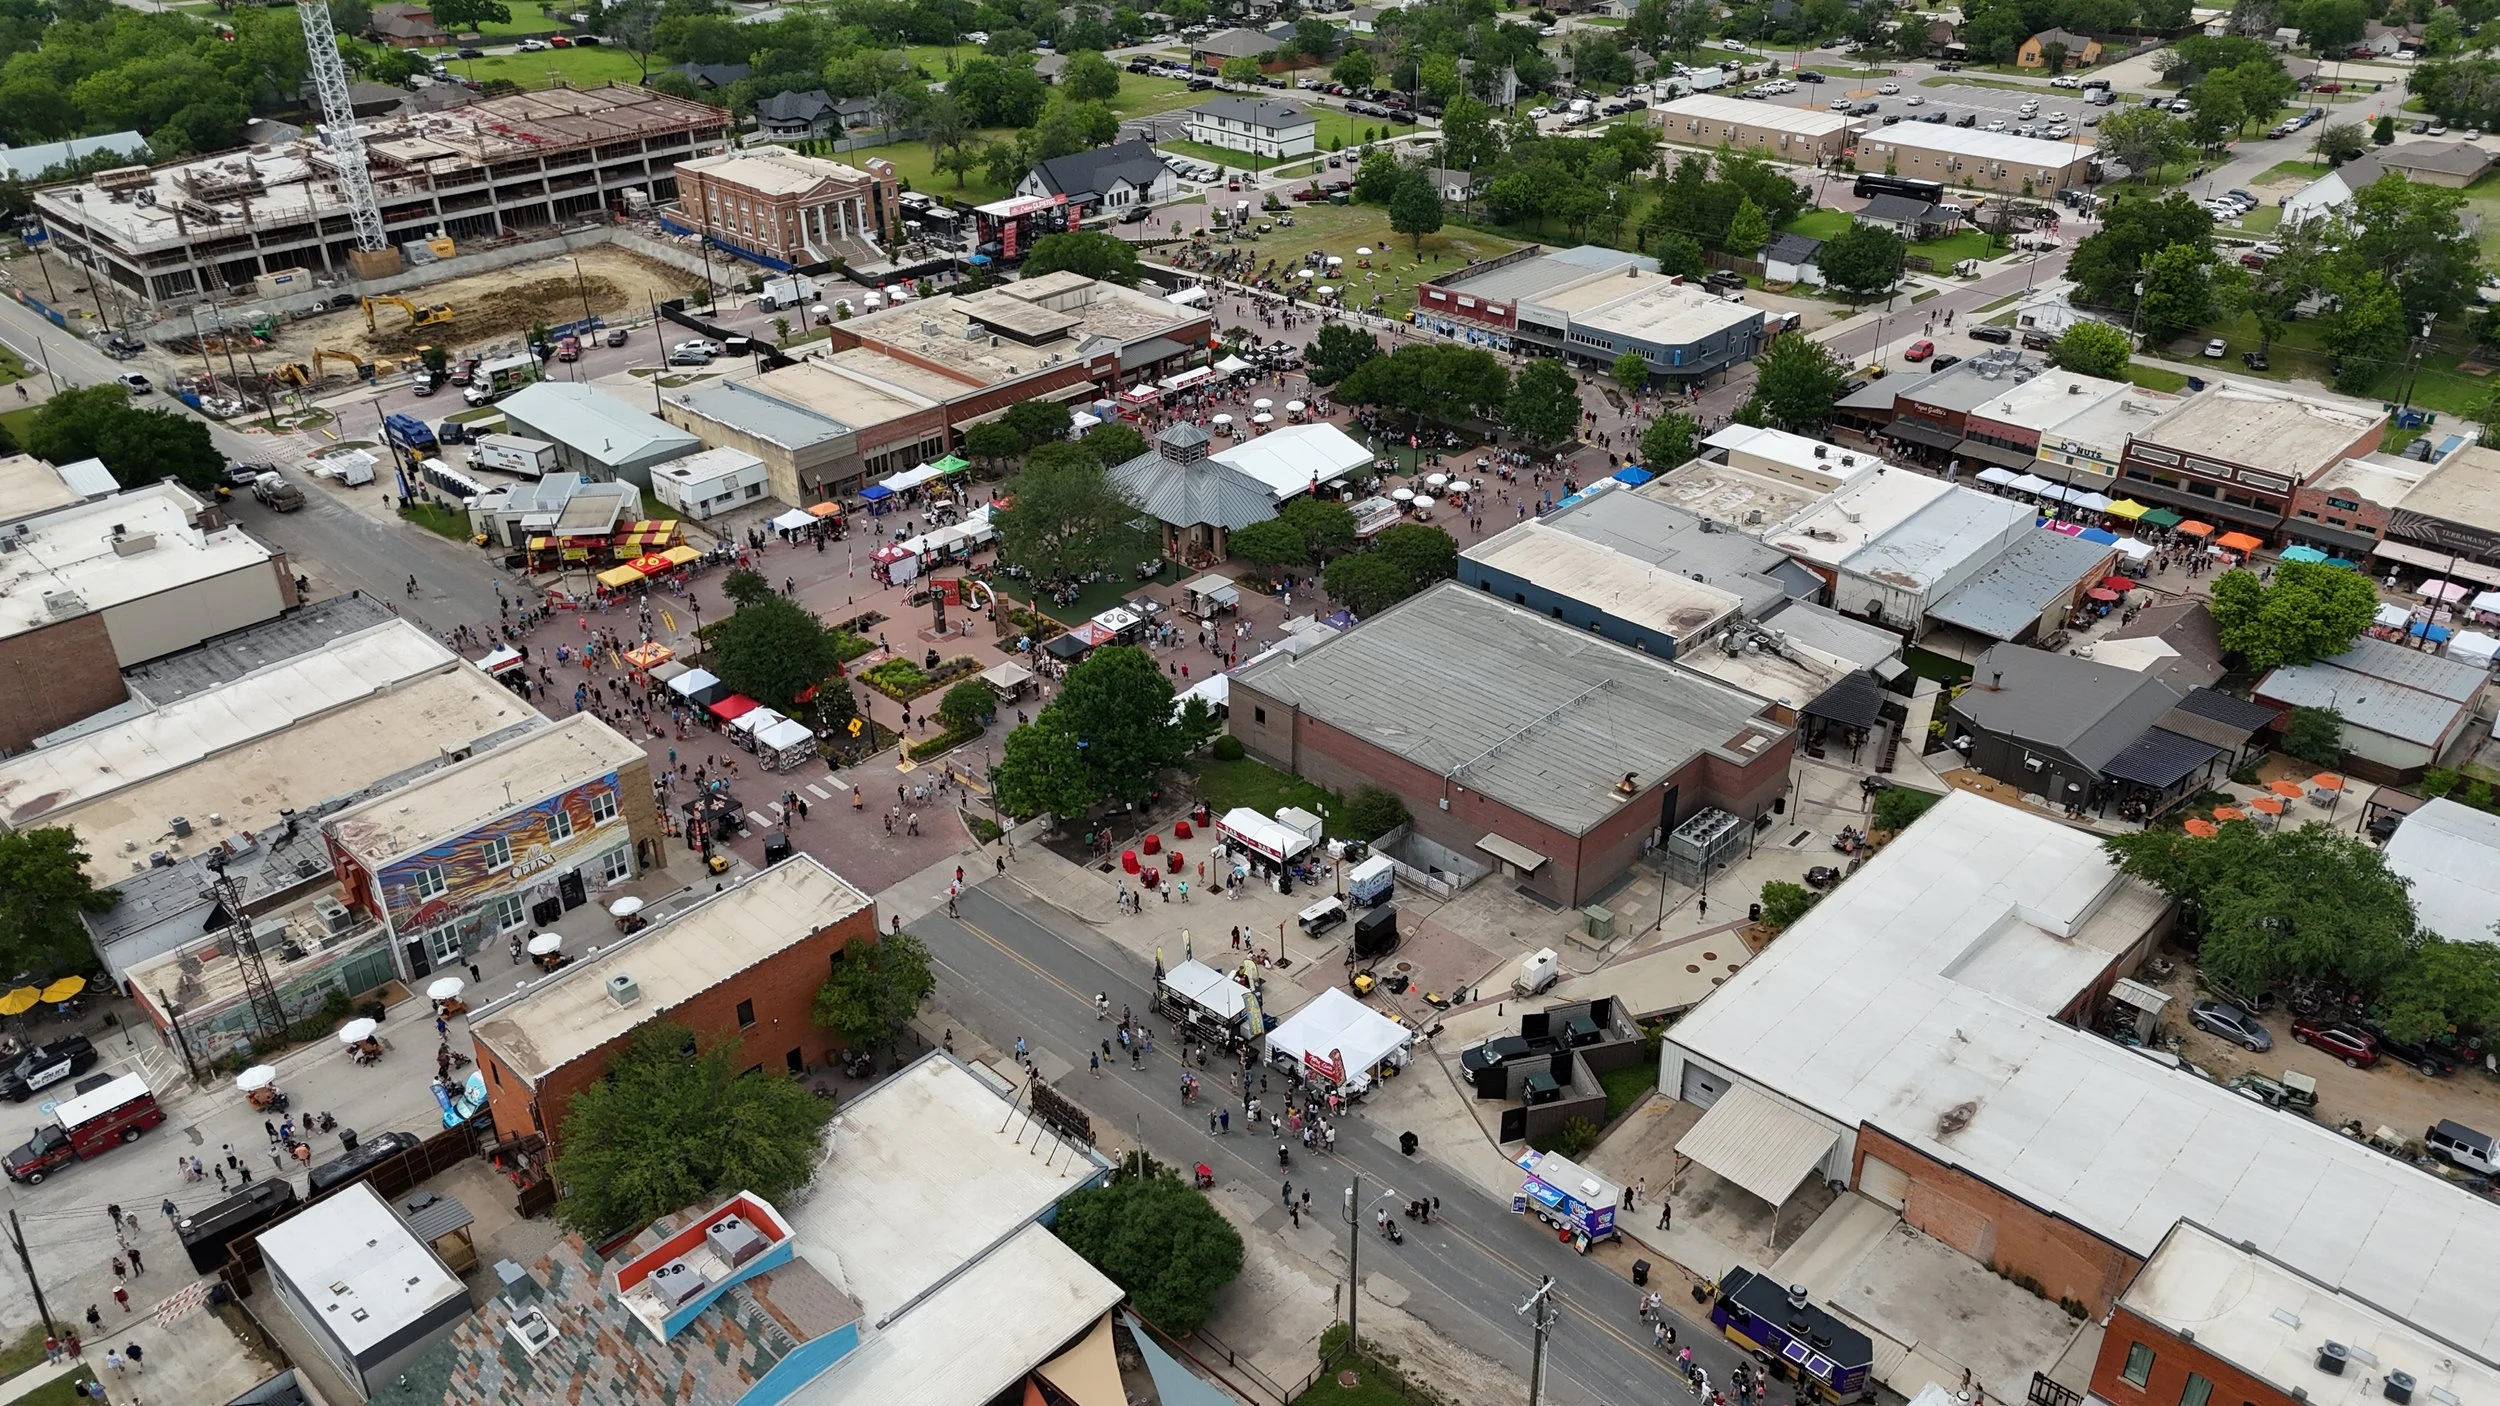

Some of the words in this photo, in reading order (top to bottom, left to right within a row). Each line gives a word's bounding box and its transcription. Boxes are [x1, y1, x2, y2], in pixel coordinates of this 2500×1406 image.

[2442, 530, 2491, 547] TERRAMANIA
[510, 853, 556, 879] CELINA
[41, 1066, 66, 1081] POLICE
